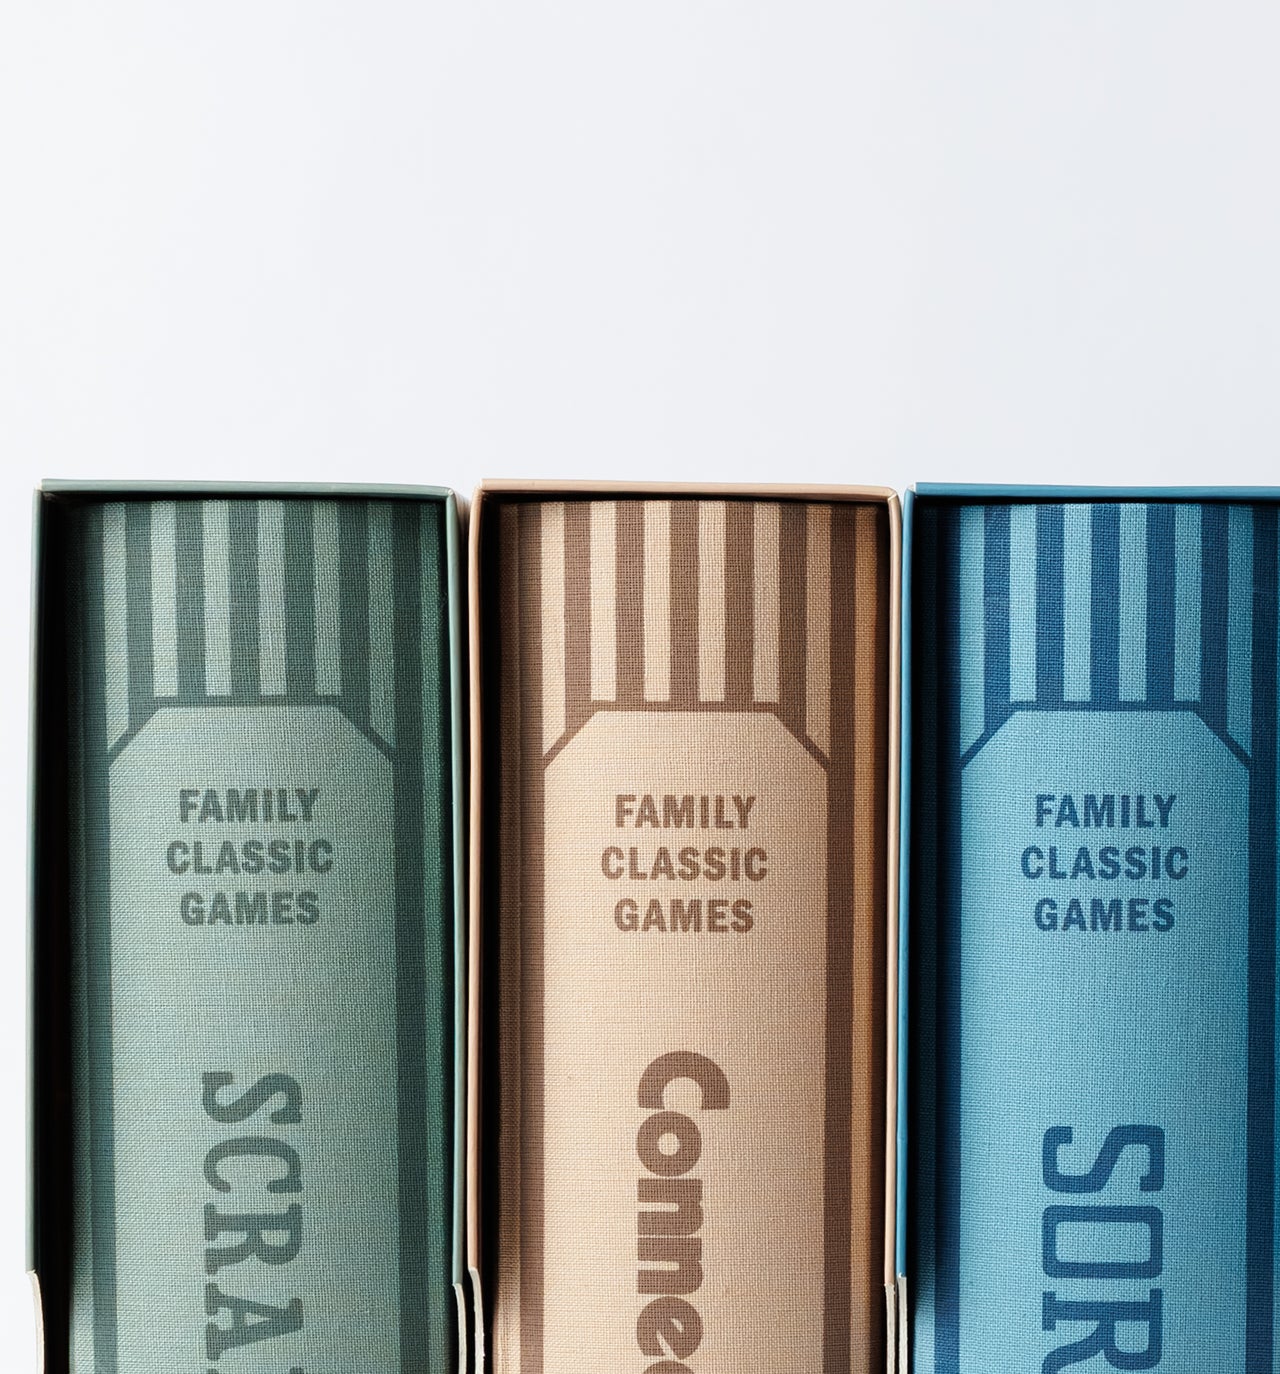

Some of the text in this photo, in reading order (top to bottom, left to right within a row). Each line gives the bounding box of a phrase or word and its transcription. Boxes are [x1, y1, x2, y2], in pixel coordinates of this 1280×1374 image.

[179, 788, 320, 823] FAMILY
[616, 793, 756, 830] FAMILY
[1036, 793, 1177, 829] FAMILY
[168, 839, 334, 876] CLASSIC
[601, 845, 768, 881] CLASSIC
[1022, 845, 1190, 880] CLASSIC
[181, 890, 320, 927] GAMES
[615, 897, 755, 934] GAMES
[1035, 896, 1176, 933] GAMES
